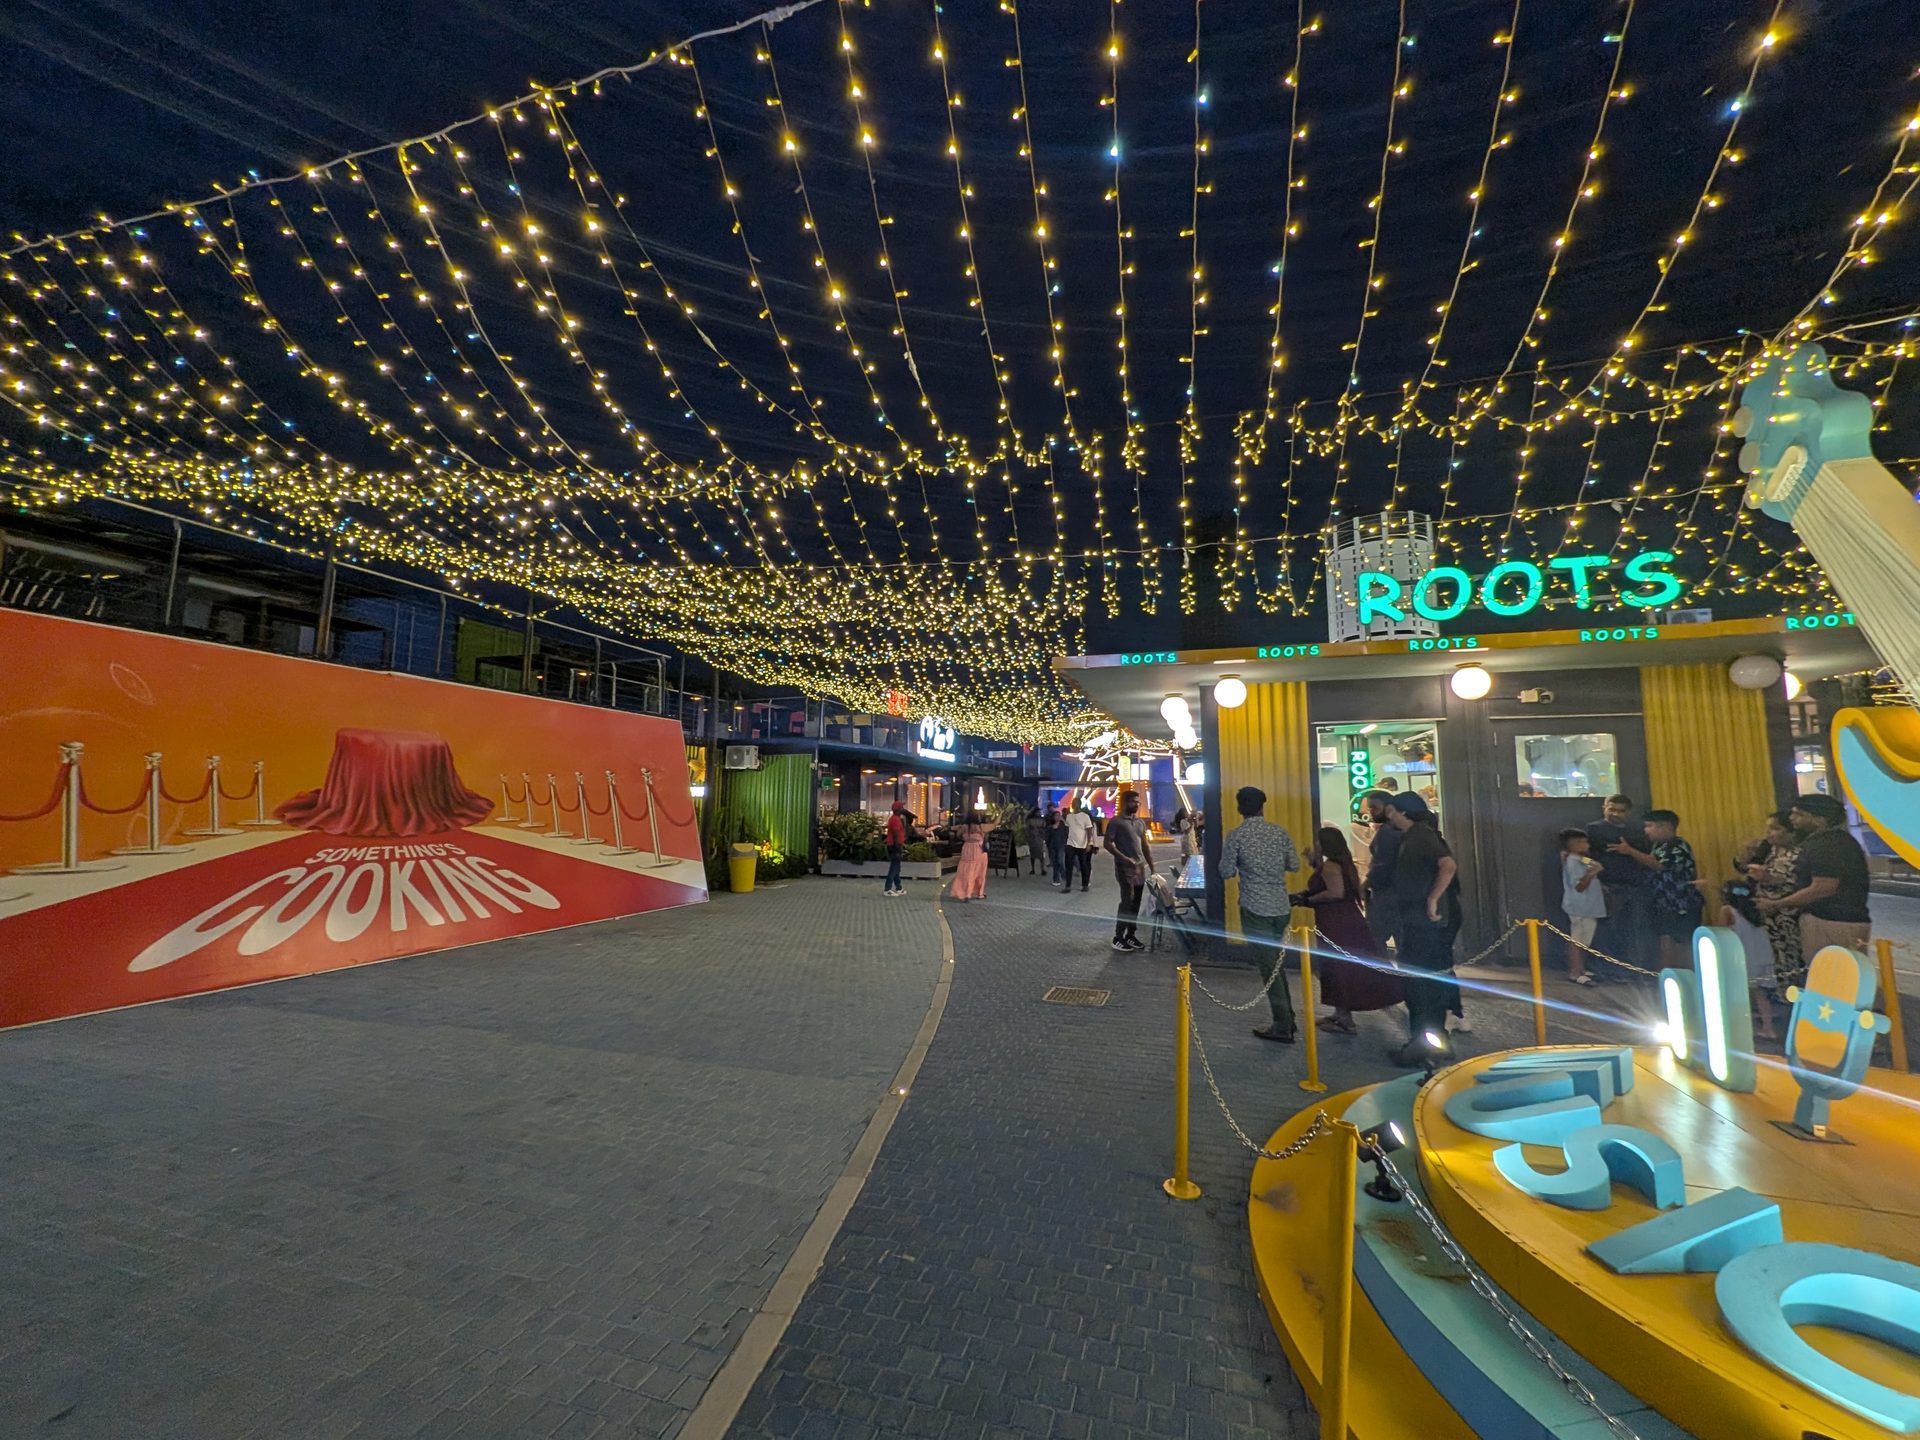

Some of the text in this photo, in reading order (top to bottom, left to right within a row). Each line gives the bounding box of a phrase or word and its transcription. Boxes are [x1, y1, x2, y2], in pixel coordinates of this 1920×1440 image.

[1357, 551, 1682, 625] ROOTS
[1785, 612, 1856, 630] ROOT
[1580, 626, 1659, 642] ROOTS
[1258, 644, 1320, 659] ROOTS
[1408, 636, 1479, 652] ROOTS
[1120, 652, 1177, 666] ROOTS
[305, 842, 467, 865] SOMETHING'S
[127, 856, 561, 973] COOKING
